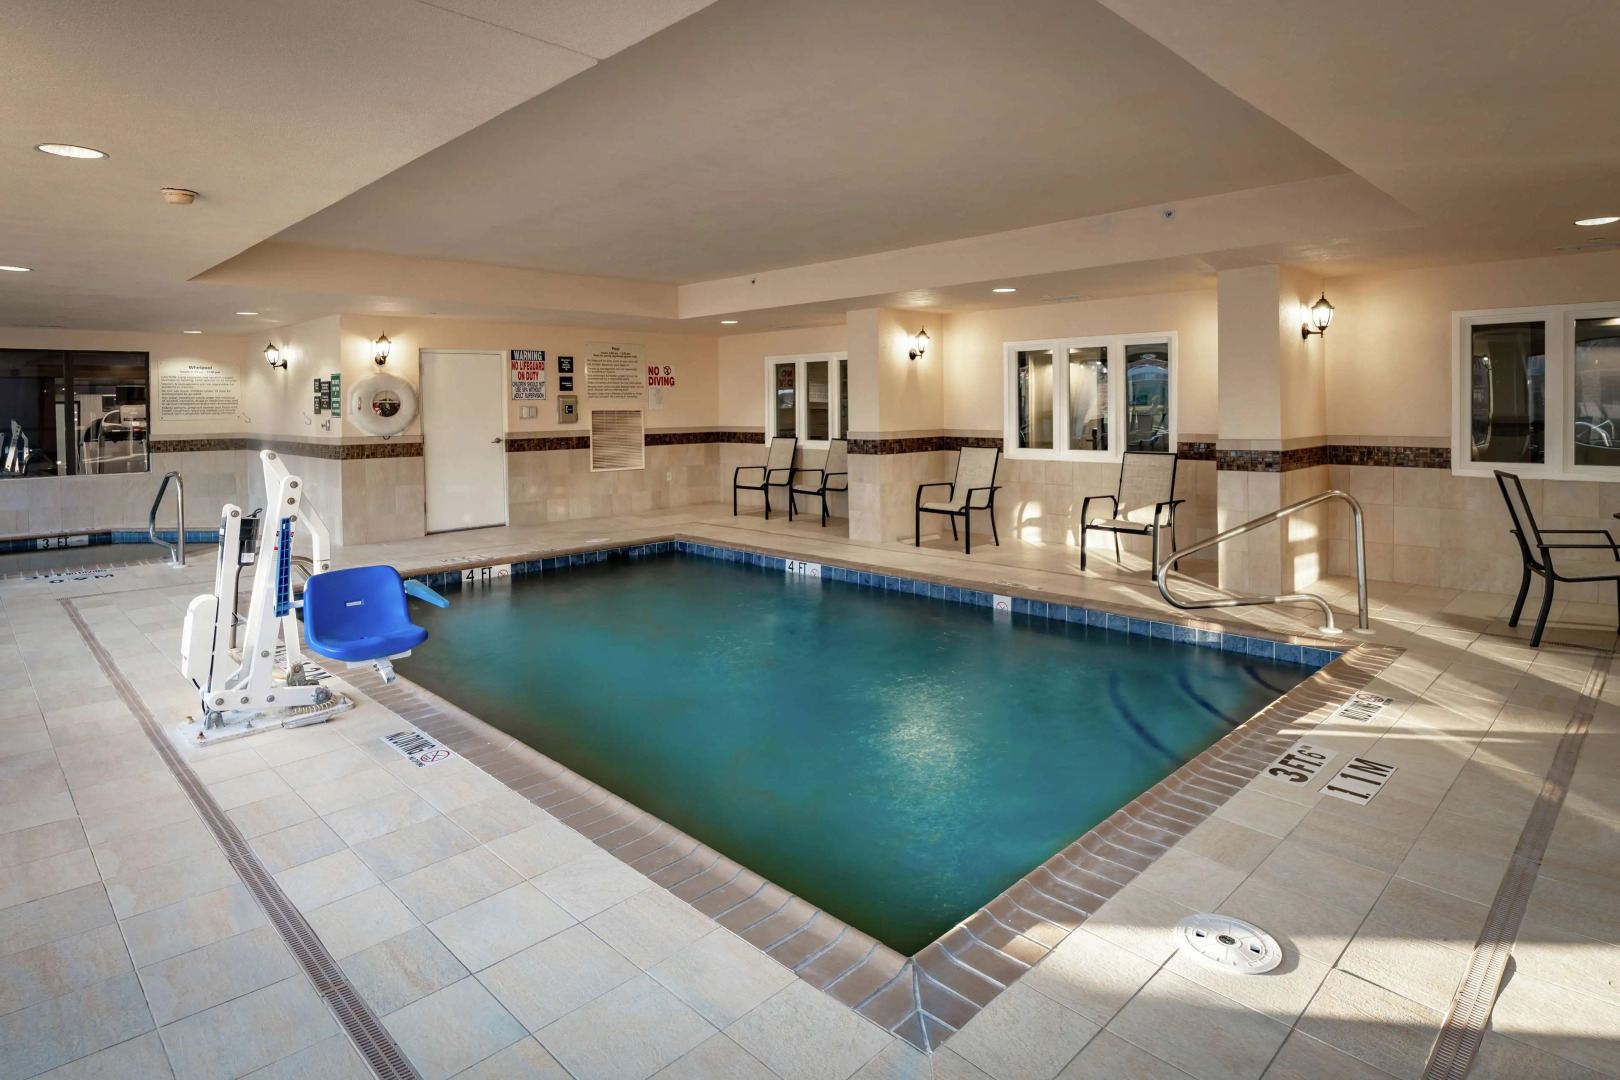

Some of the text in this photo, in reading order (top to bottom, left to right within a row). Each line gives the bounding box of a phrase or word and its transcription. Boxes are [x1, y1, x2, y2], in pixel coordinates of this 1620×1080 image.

[514, 351, 543, 361] WARNING
[512, 361, 545, 371] NO LIFEGUARD
[648, 366, 660, 376] NO
[518, 372, 538, 380] ON DUTY
[648, 377, 675, 386] DIVING
[42, 538, 50, 549] 3
[788, 560, 807, 574] 4 FT
[466, 566, 493, 580] 4 FT
